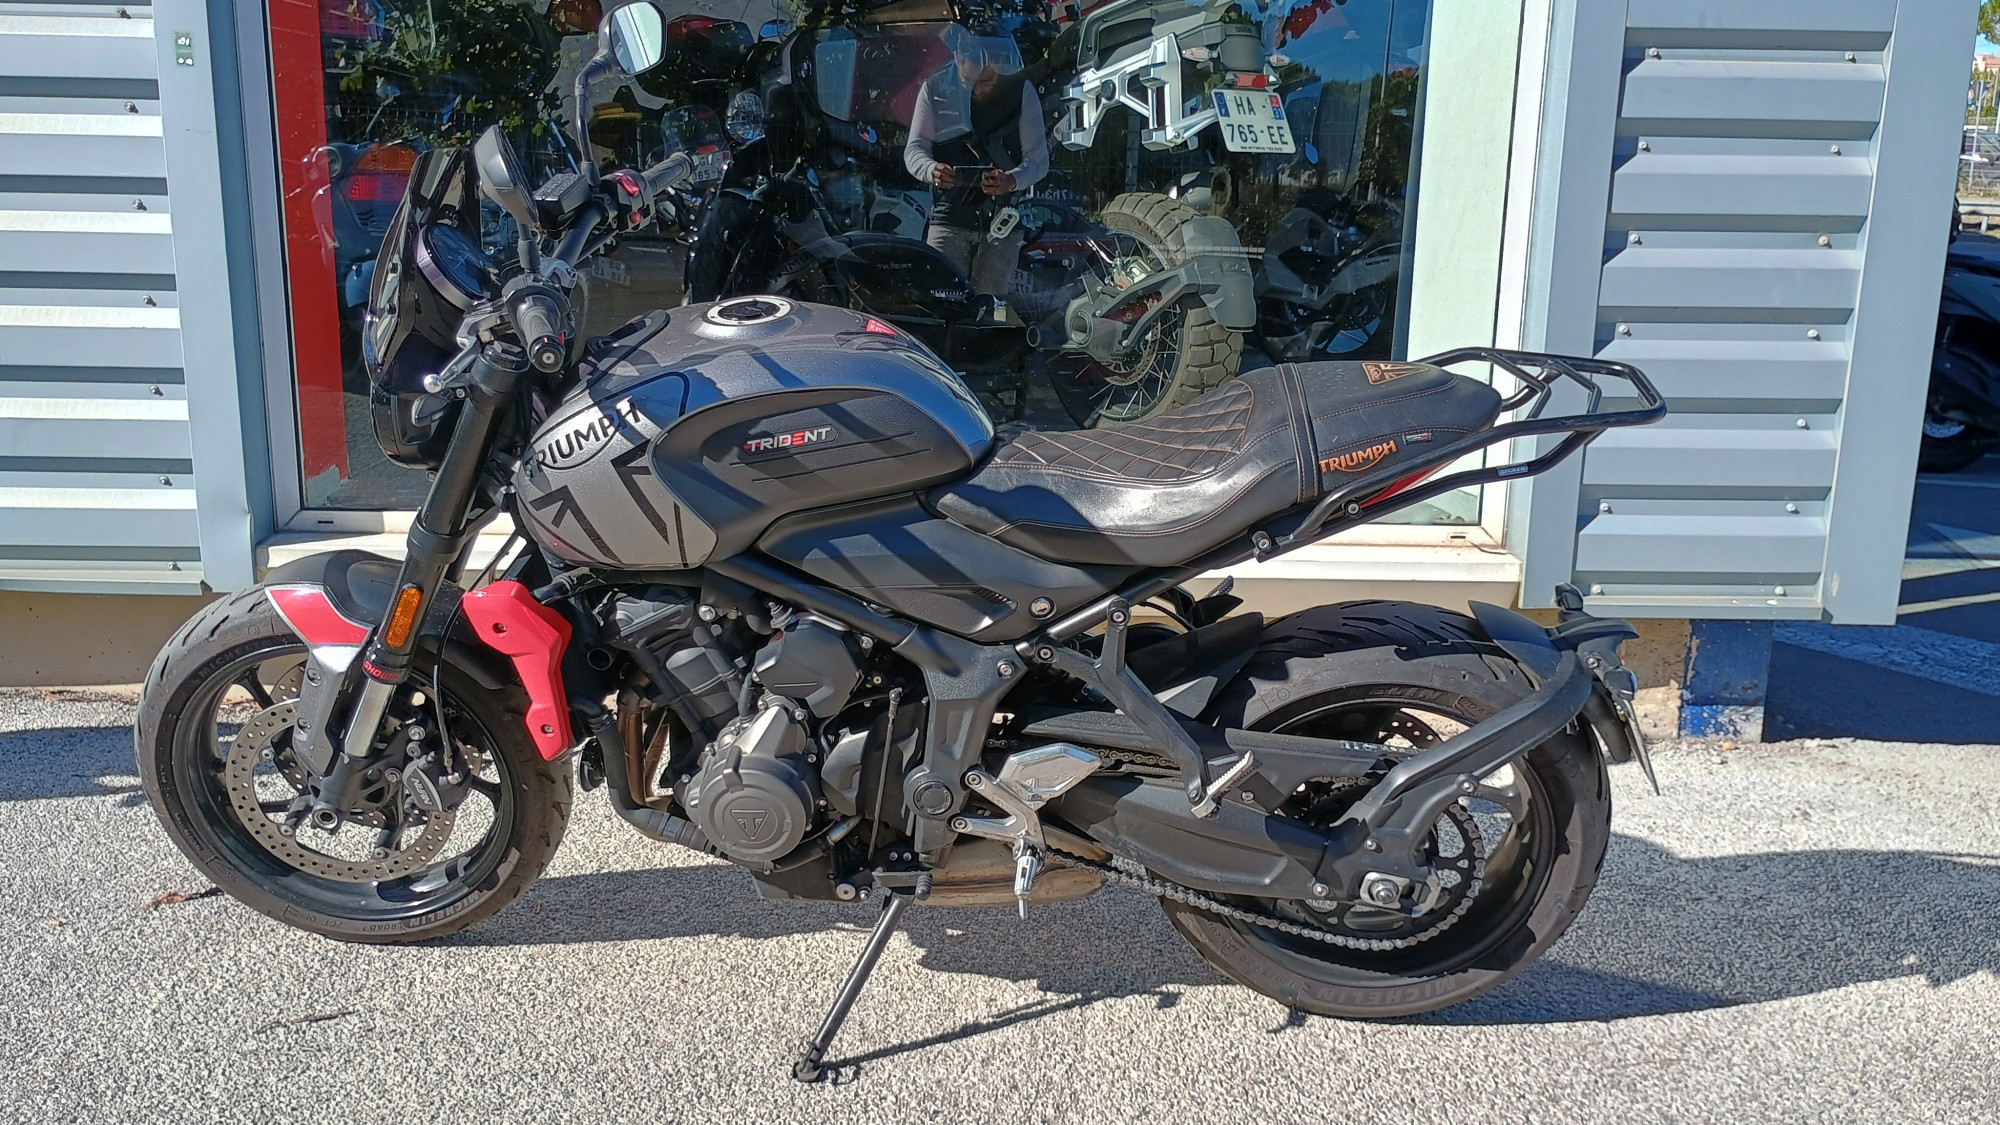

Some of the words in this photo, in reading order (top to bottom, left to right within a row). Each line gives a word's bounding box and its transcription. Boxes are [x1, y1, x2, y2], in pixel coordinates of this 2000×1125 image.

[1233, 95, 1257, 116] HA
[1273, 109, 1284, 119] 31
[1225, 123, 1289, 146] 765-EE
[744, 427, 832, 453] TRIDENT
[1318, 439, 1398, 474] TRIUMPH
[409, 889, 482, 928] MICHELIN
[1315, 978, 1456, 1005] MICHELIN
